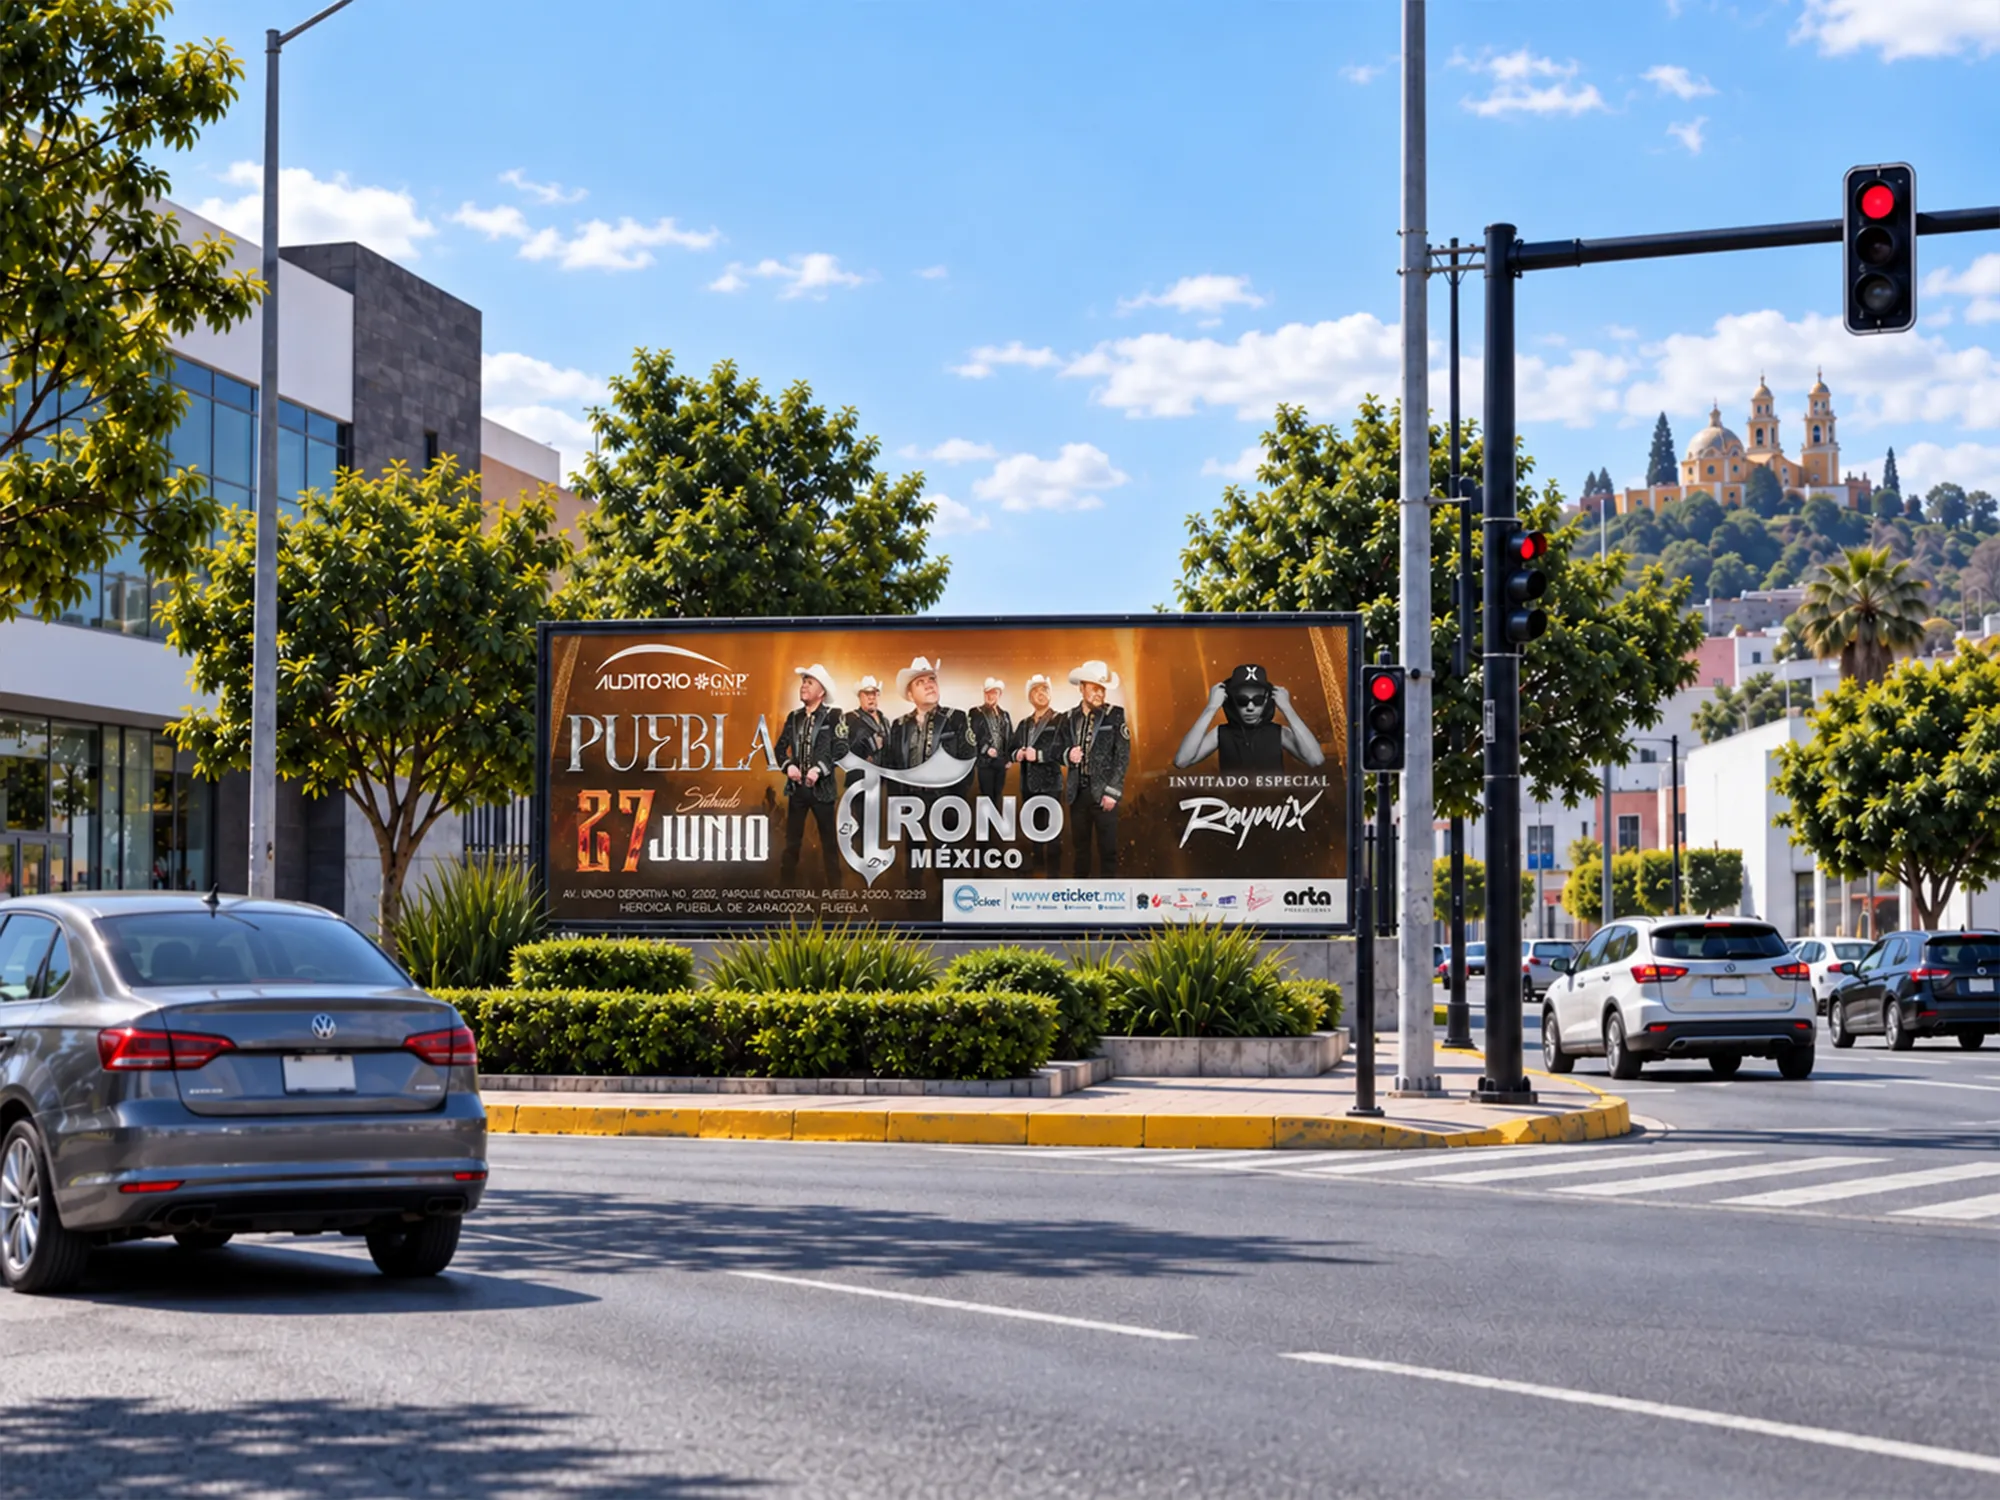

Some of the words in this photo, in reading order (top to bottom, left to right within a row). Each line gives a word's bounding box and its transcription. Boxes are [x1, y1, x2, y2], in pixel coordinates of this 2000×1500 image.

[595, 673, 692, 690] AUDITORIO
[710, 673, 746, 689] GNP
[566, 713, 782, 772] PUEBLA
[1169, 776, 1249, 788] INVITADO
[1256, 775, 1330, 788] ESPECIAL
[576, 789, 656, 872] 27
[649, 815, 769, 862] JUNIO
[911, 844, 1023, 869] MÉXICO
[1283, 886, 1332, 906] arta
[619, 902, 672, 912] HEROICA
[675, 902, 723, 913] PUEBLA
[727, 902, 743, 913] DE
[821, 902, 869, 913] PUEBLA
